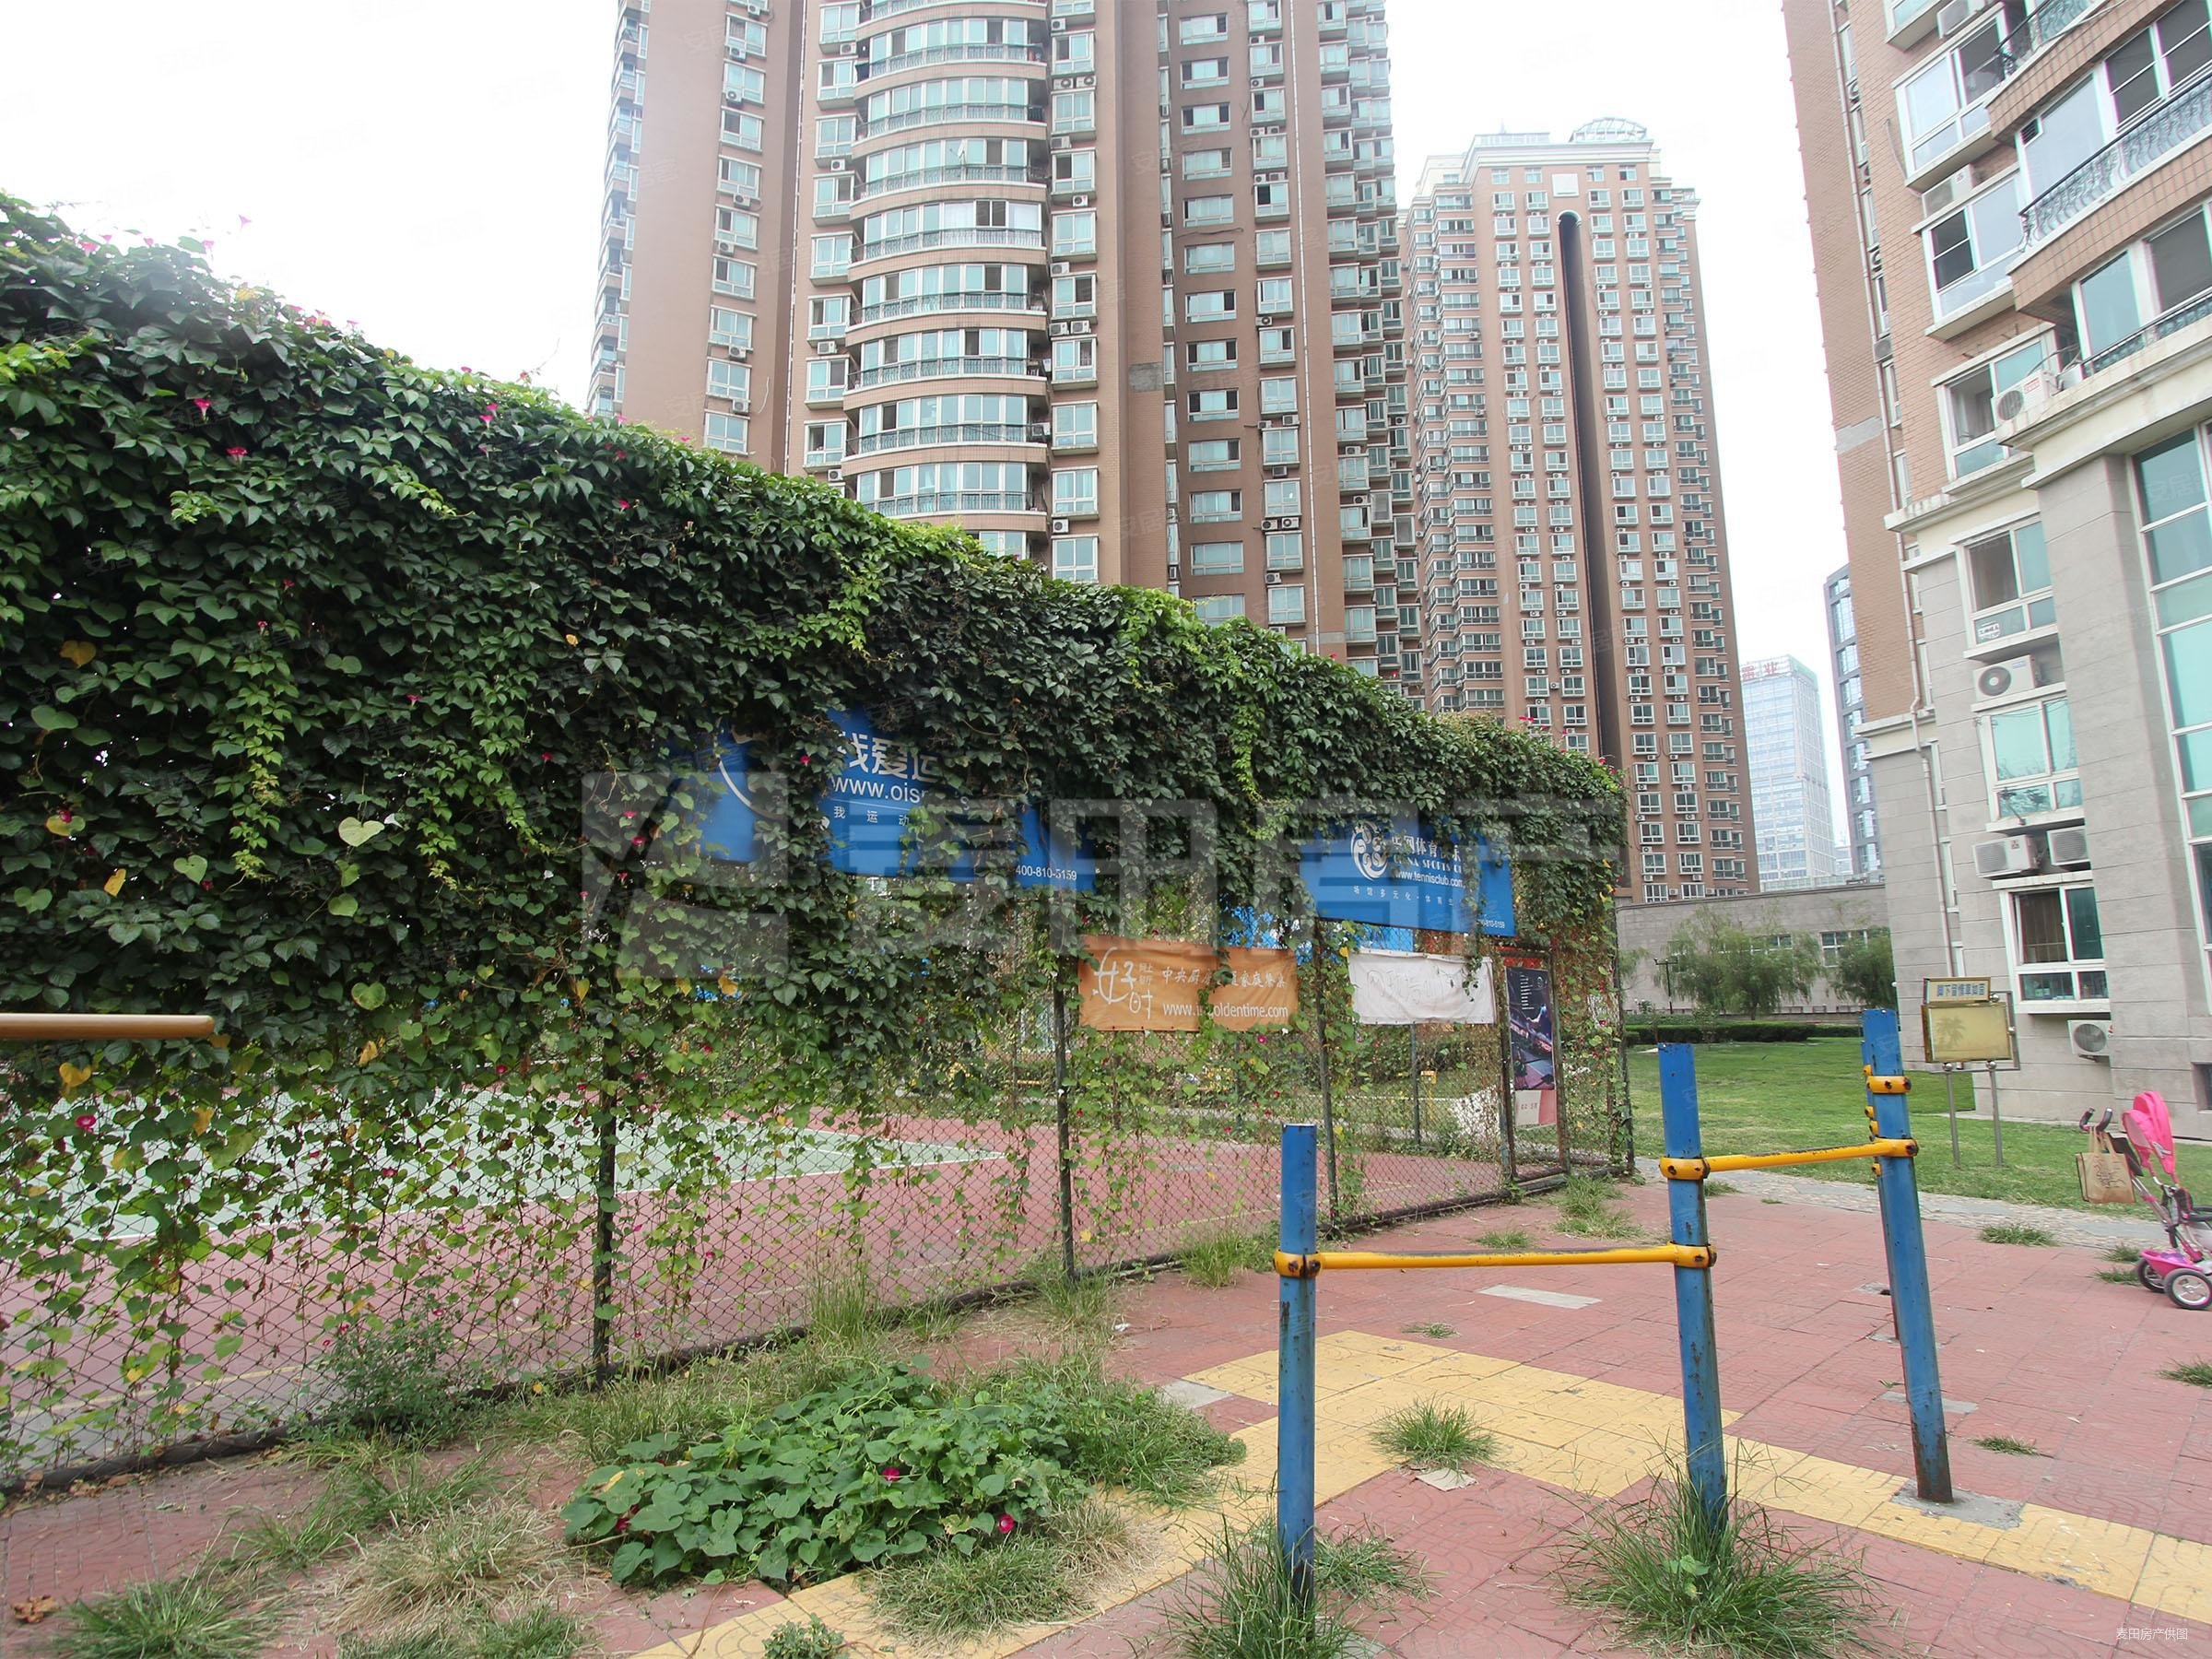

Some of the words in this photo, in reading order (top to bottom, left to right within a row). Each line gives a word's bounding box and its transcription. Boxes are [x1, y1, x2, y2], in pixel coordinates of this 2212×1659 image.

[1015, 865, 1077, 881] 400-810-5159
[1161, 965, 1287, 989] 中央厨房家庭餐桌
[1163, 1002, 1288, 1019] www.ioldentime.com
